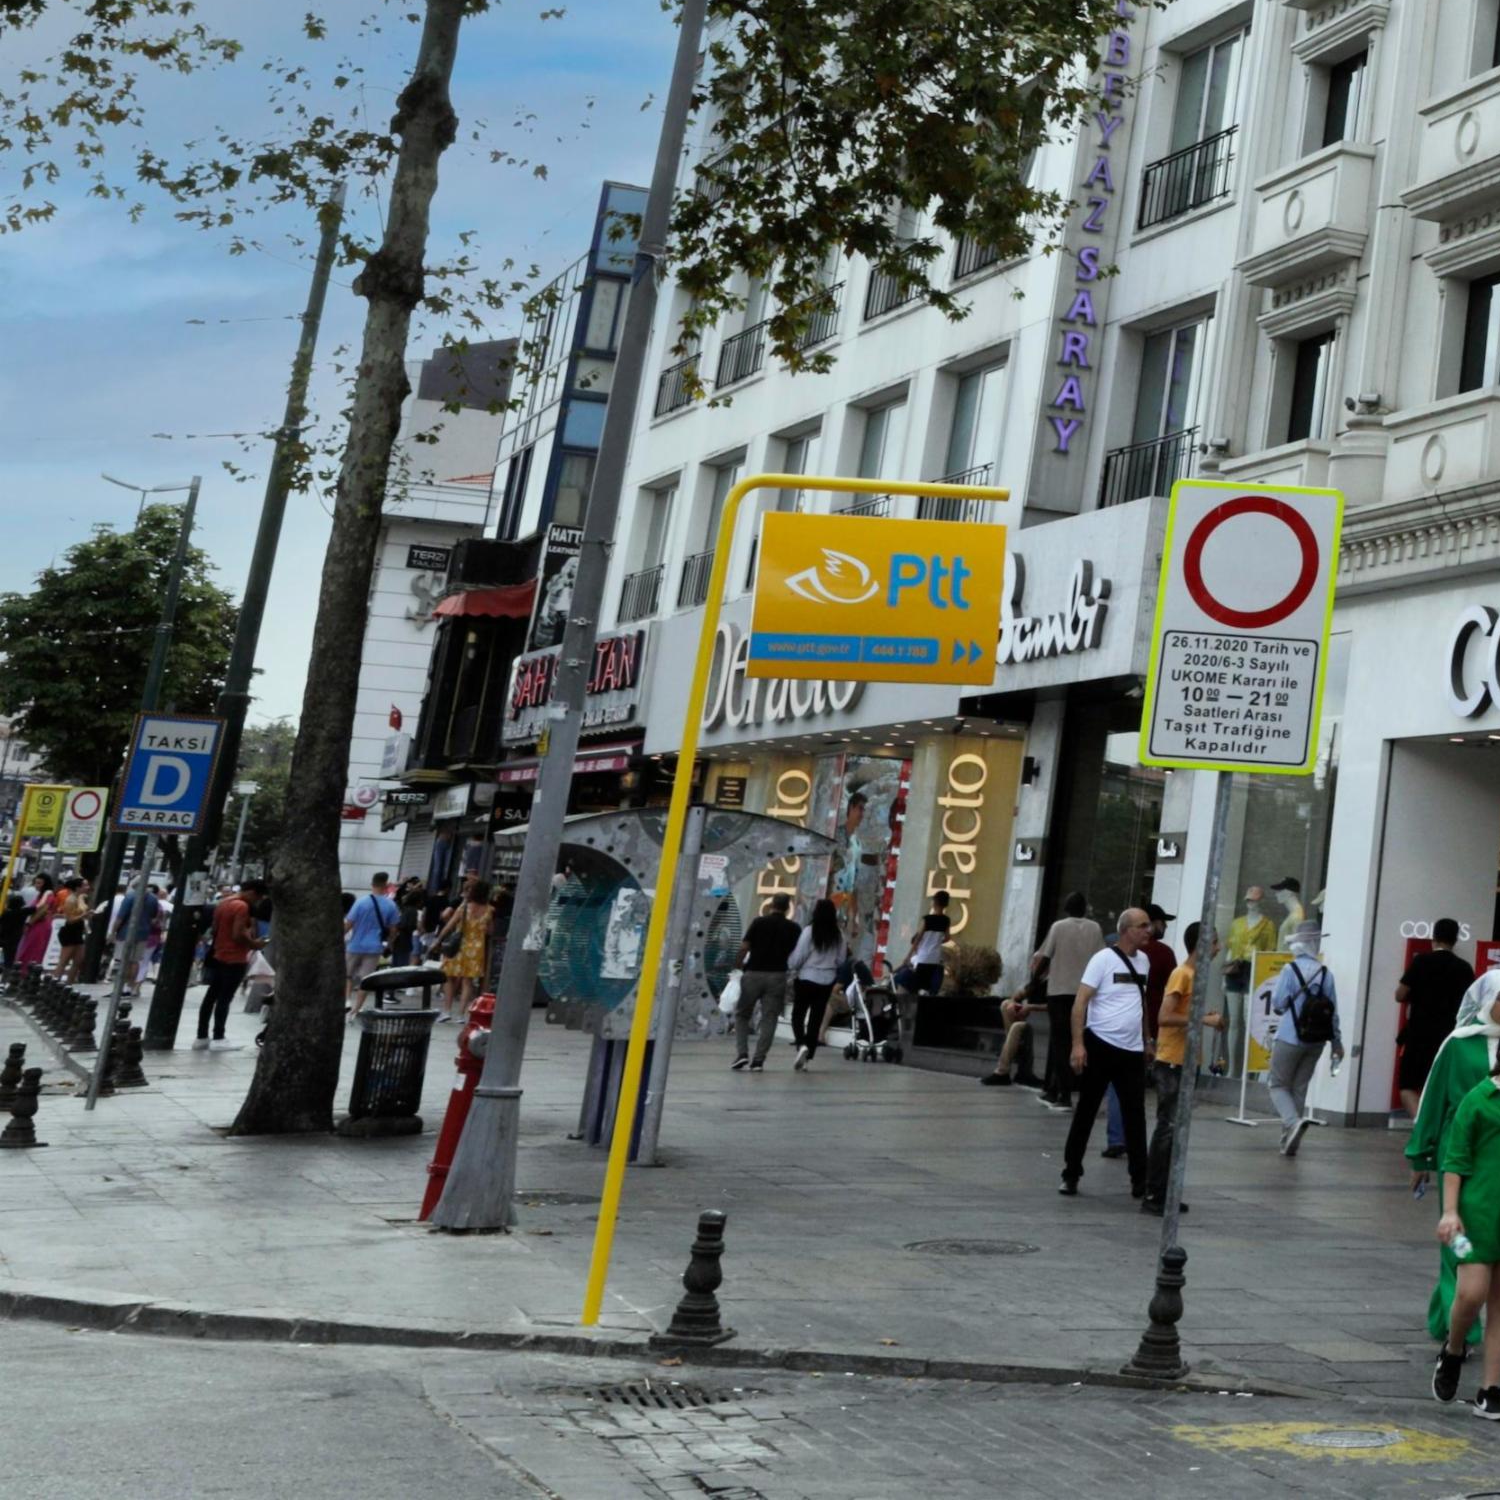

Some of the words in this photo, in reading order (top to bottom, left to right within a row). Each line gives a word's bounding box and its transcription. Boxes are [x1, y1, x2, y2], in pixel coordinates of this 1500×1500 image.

[1082, 31, 1131, 234] BEYAZ
[1048, 246, 1100, 455] SARAY
[887, 553, 971, 610] Ptt
[1172, 636, 1248, 652] 26.11.2020
[1254, 641, 1289, 655] Tarih
[1293, 647, 1310, 656] ve
[1184, 654, 1245, 669] 2020/6-3
[1249, 658, 1289, 674] Sayılı
[1171, 669, 1227, 684] UKOME
[1232, 674, 1276, 688] Kararı
[1281, 678, 1298, 689] ile
[1184, 704, 1240, 719] Saatleri
[1243, 709, 1282, 722] Arası
[1164, 719, 1206, 735] Taşıt
[1213, 722, 1291, 739] Trafiğine
[147, 735, 208, 750] TAKSİ
[1185, 738, 1267, 754] Kapalıdır
[139, 755, 191, 806] D
